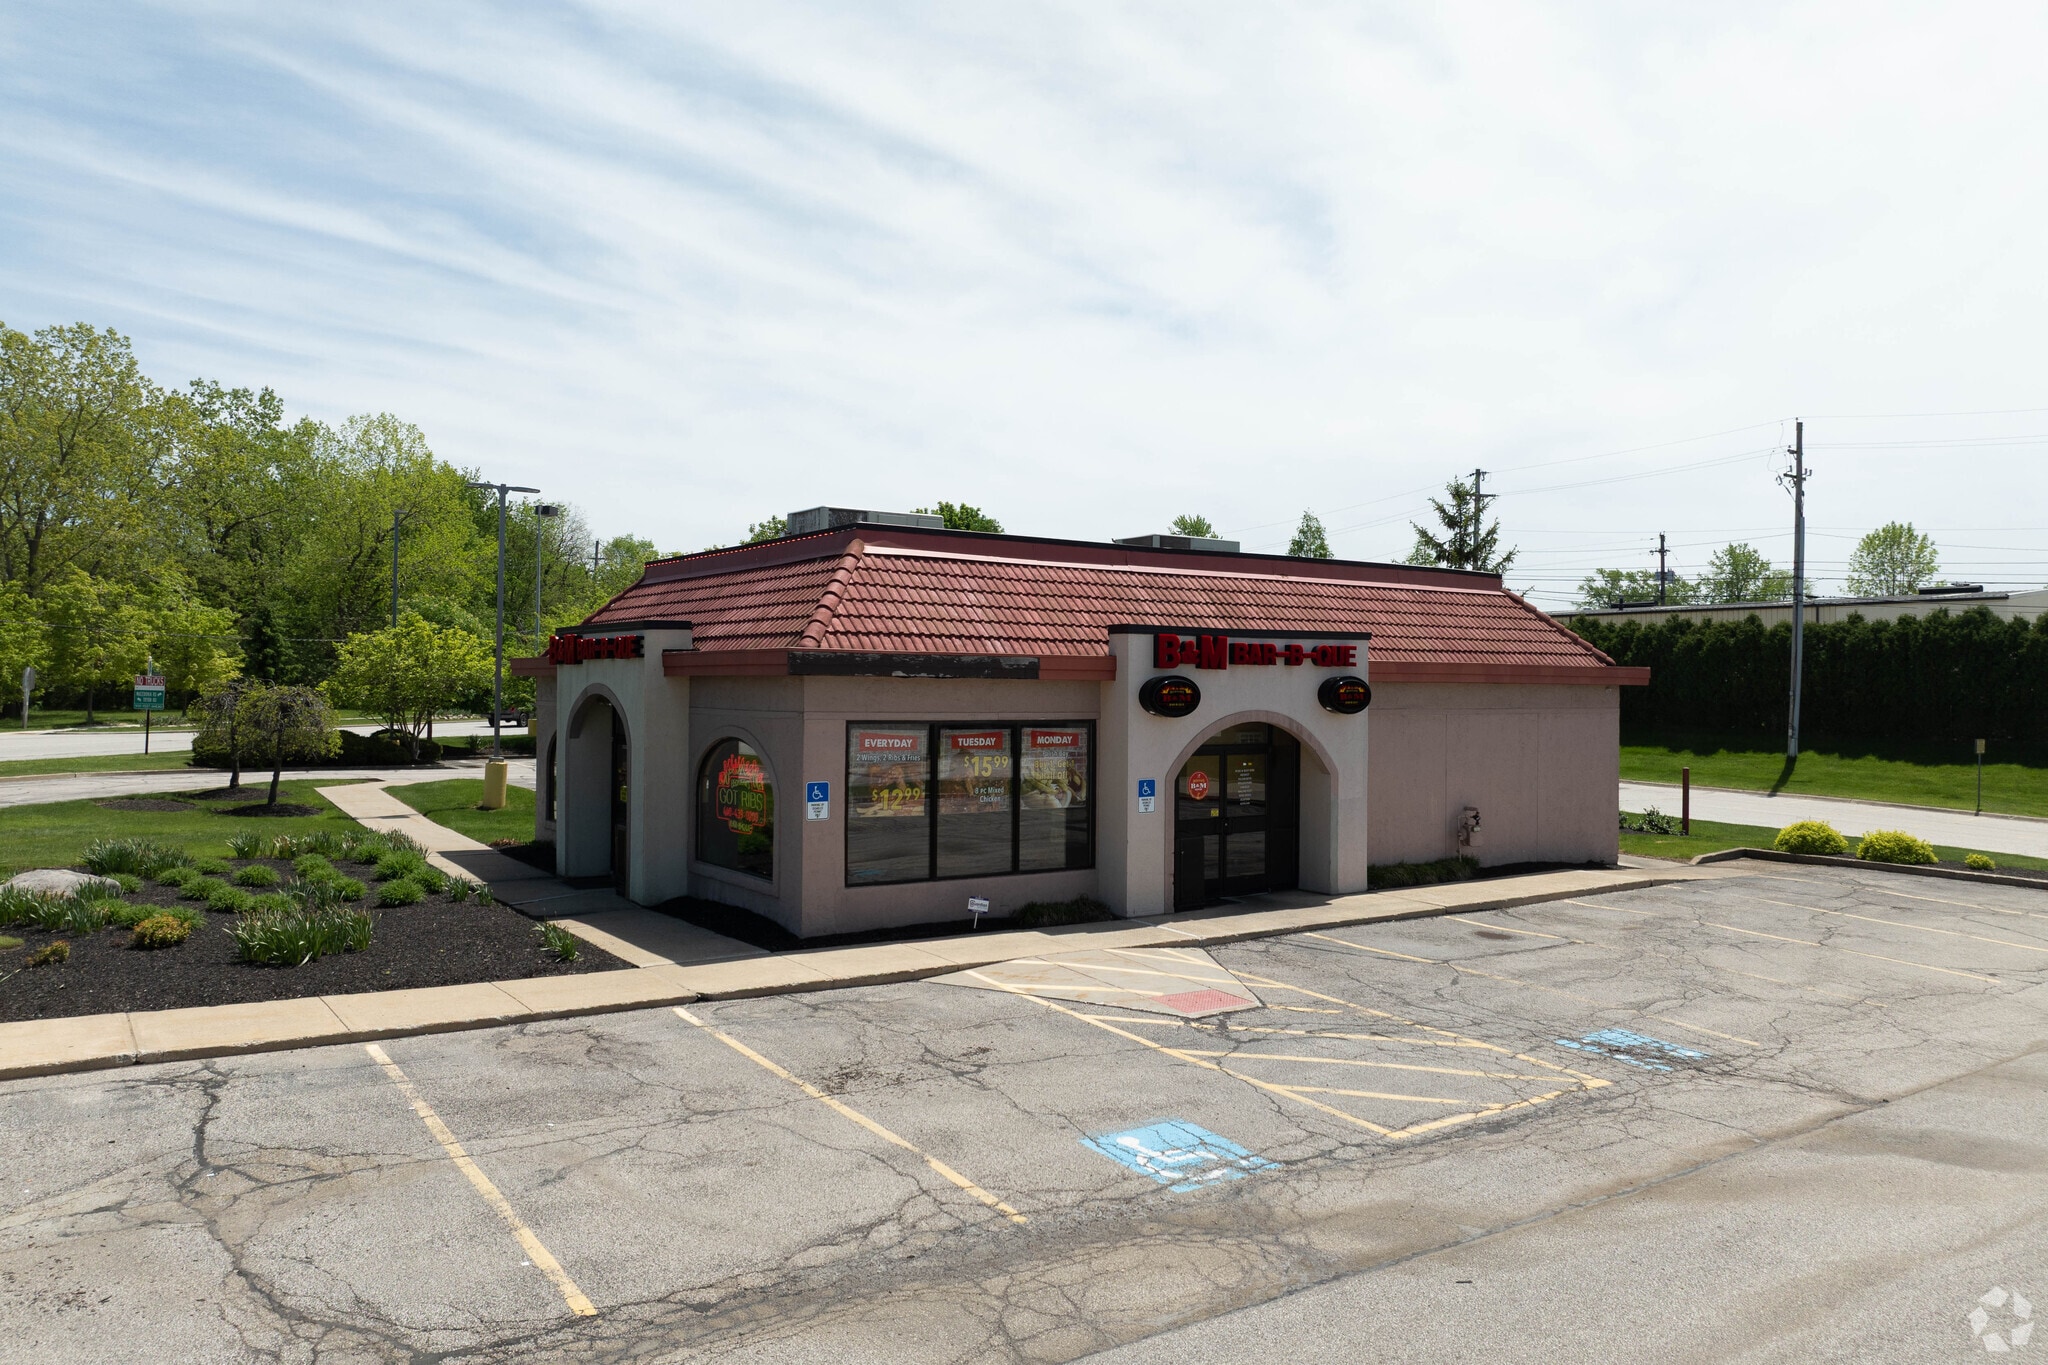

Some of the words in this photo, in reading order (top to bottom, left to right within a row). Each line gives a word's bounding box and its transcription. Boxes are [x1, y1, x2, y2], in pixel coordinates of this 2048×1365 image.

[1154, 633, 1228, 670] B&M
[1229, 642, 1357, 666] BAR-B-QUE
[146, 676, 164, 685] TRUCKS
[864, 739, 913, 748] EVERYDAY
[958, 738, 996, 746] TUESDAY
[1037, 736, 1073, 744] MONDAY
[1034, 760, 1048, 769] Buy
[1057, 760, 1069, 768] Get
[987, 786, 1005, 794] Mixed
[719, 787, 739, 805] GOT
[741, 791, 763, 811] RIBS
